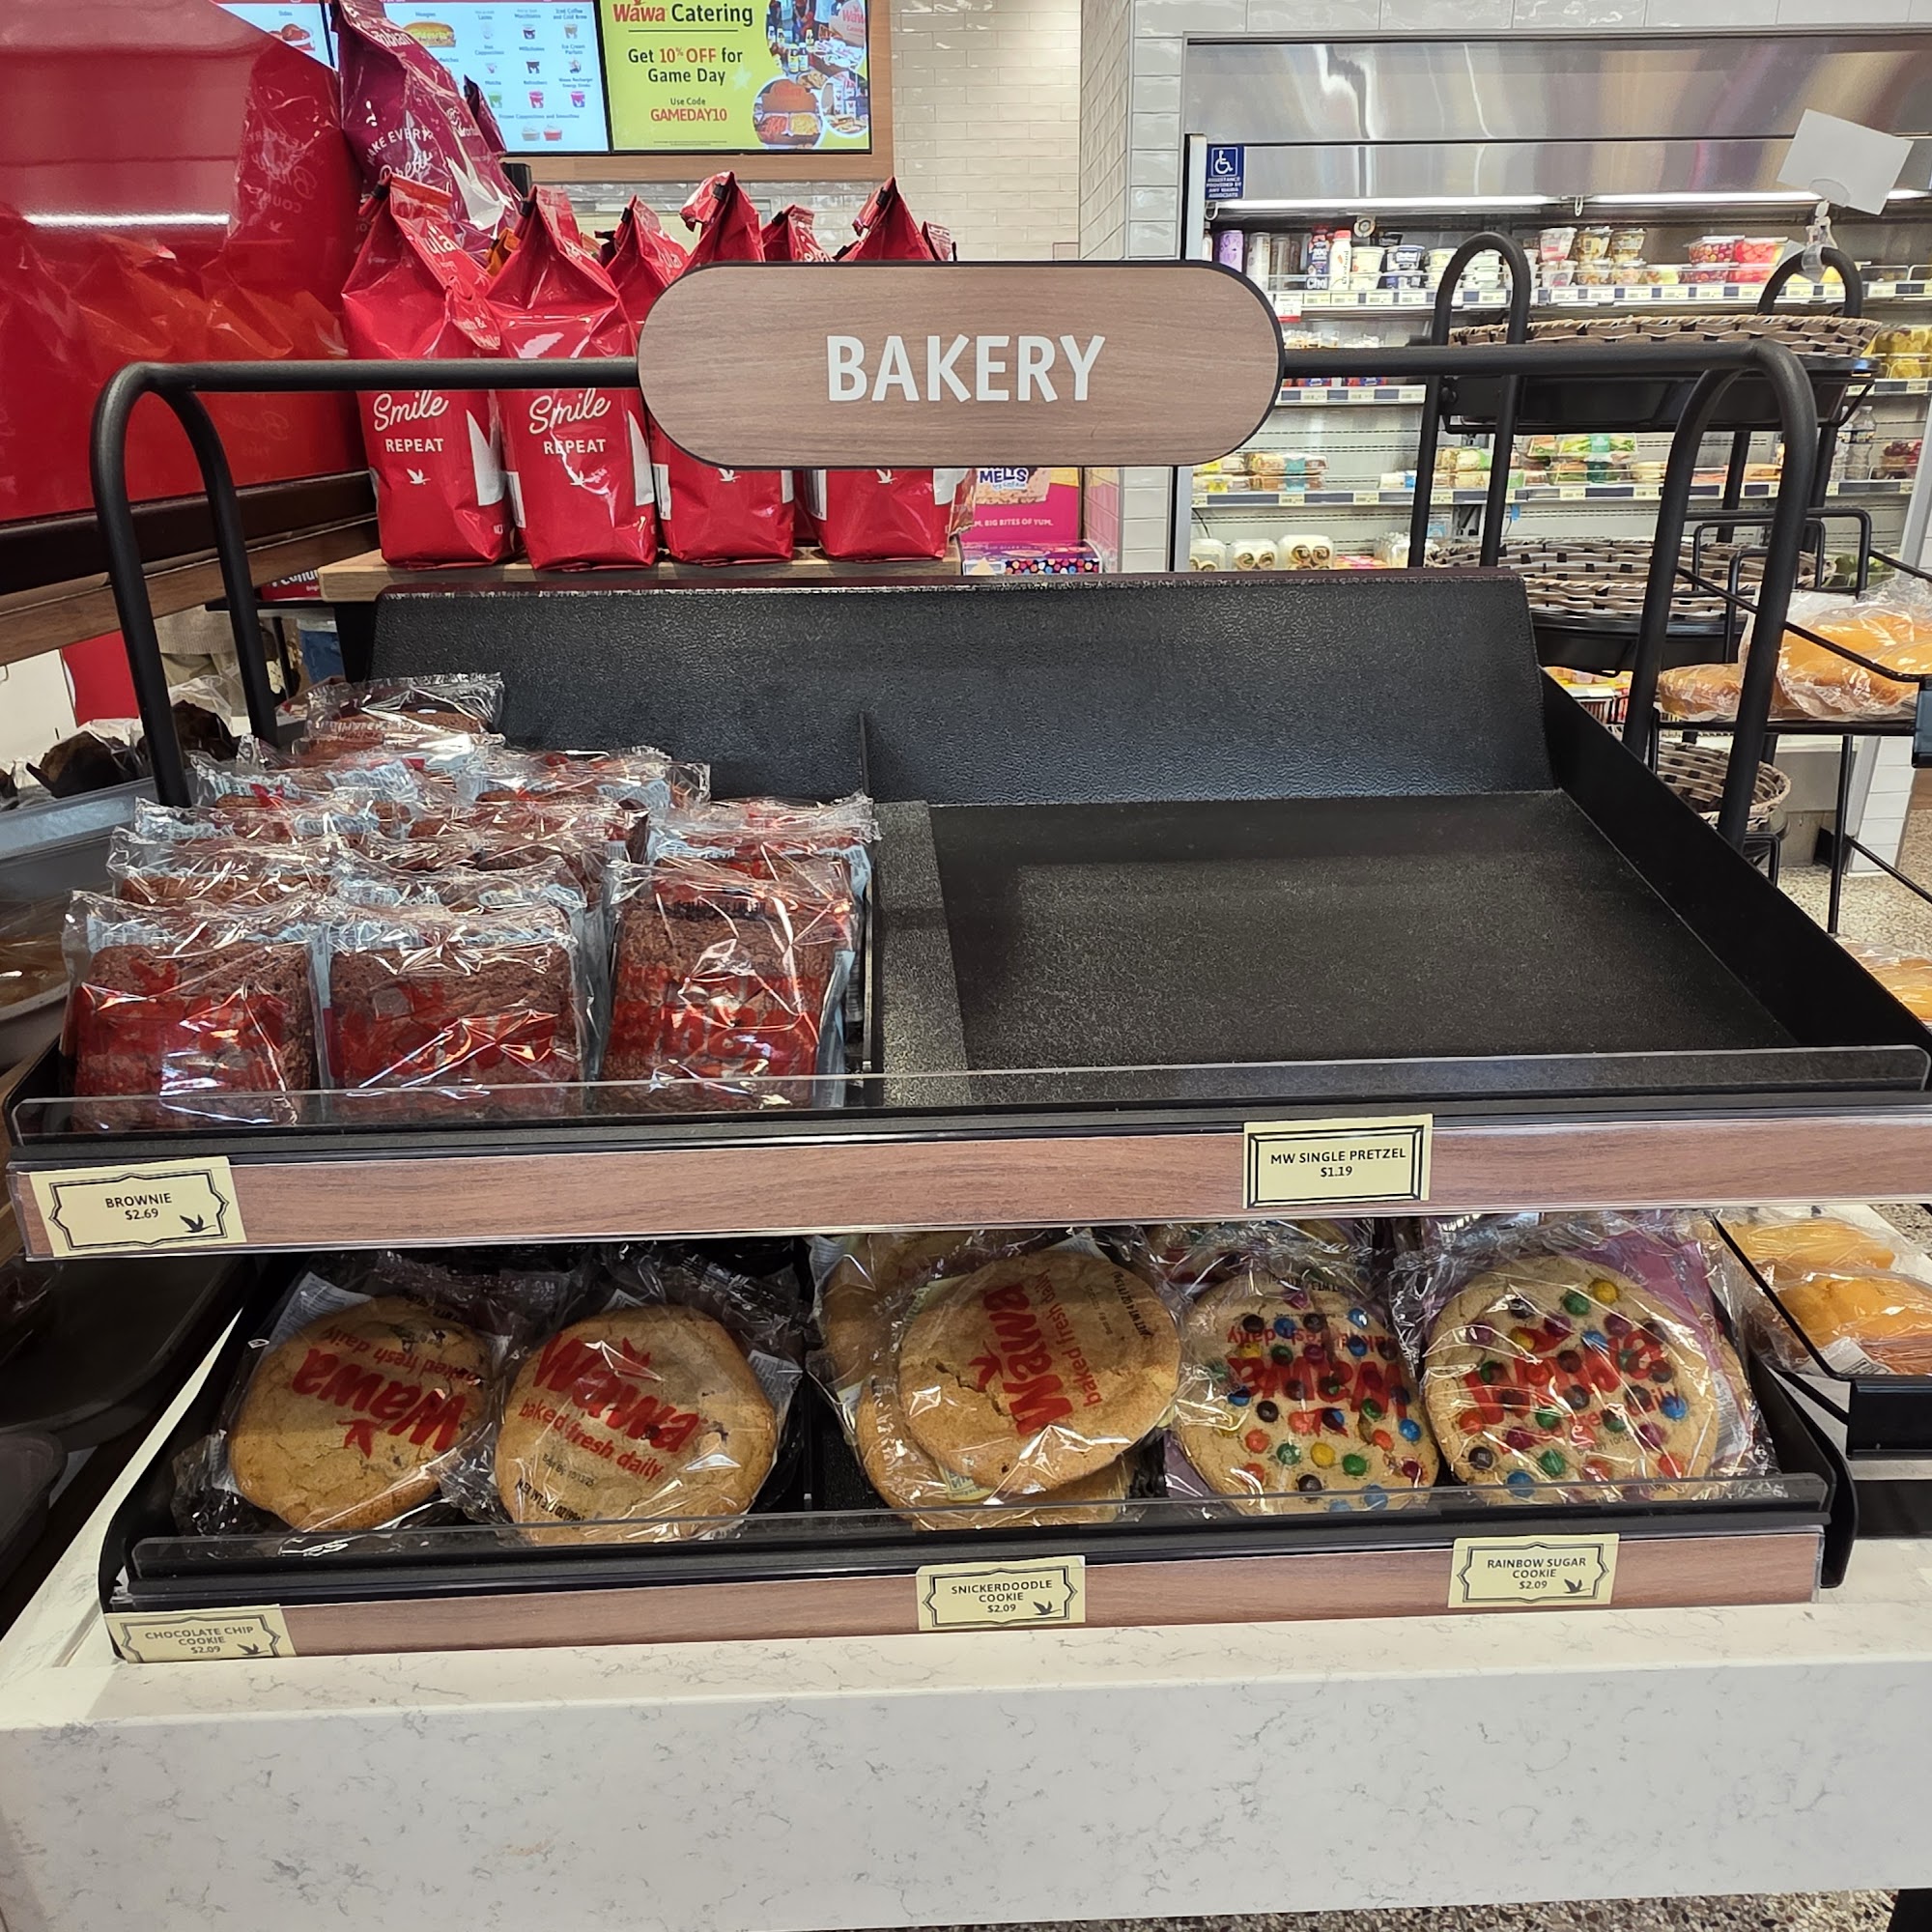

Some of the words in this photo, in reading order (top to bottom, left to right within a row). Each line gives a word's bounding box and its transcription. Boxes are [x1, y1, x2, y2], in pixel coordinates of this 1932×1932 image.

[612, 4, 667, 23] Wawa
[671, 4, 753, 27] Catering
[628, 48, 654, 64] Get
[660, 47, 684, 63] 10%
[686, 48, 717, 63] OFF
[721, 47, 743, 63] for
[647, 68, 693, 83] Game
[696, 68, 726, 86] Day
[669, 98, 685, 106] Use
[686, 98, 706, 106] Code
[650, 108, 727, 122] GAMEDAY10
[387, 128, 433, 144] EVERY
[827, 334, 1106, 403] BAKERY
[373, 389, 449, 432] Smile
[528, 388, 611, 435] Smile
[385, 438, 445, 453] REPEAT
[543, 438, 607, 455] REPEAT
[1270, 1153, 1295, 1165] MW
[1298, 1151, 1346, 1163] SINGLE
[1350, 1148, 1406, 1160] PRETZEL
[1320, 1166, 1353, 1178] $1.19
[105, 1192, 173, 1208] BROWNIE
[125, 1208, 159, 1221] $2.69
[1034, 1269, 1057, 1308] daily
[1046, 1303, 1078, 1356] fresh
[321, 1325, 371, 1356] daily
[374, 1345, 419, 1374] fresh
[982, 1283, 1073, 1437] Wawa
[1061, 1341, 1103, 1408] baked
[532, 1331, 700, 1453] Wawa
[1227, 1356, 1407, 1420] Wawa
[292, 1348, 467, 1453] Wawa
[518, 1399, 569, 1430] baked
[564, 1419, 614, 1461] fresh
[616, 1449, 665, 1482] daily
[1488, 1558, 1545, 1569] RAINBOW
[1547, 1557, 1586, 1568] SUGAR
[1512, 1569, 1557, 1579] COOKIE
[951, 1579, 1053, 1595] SNICKERDOODLE
[1519, 1580, 1548, 1589] $2.09
[979, 1592, 1024, 1604] COOKIE
[986, 1605, 1016, 1613] $2.09
[145, 1628, 221, 1640] CHOCOLATE
[224, 1626, 254, 1635] CHIP
[178, 1635, 226, 1646] COOKIE
[190, 1645, 221, 1655] $2.09
